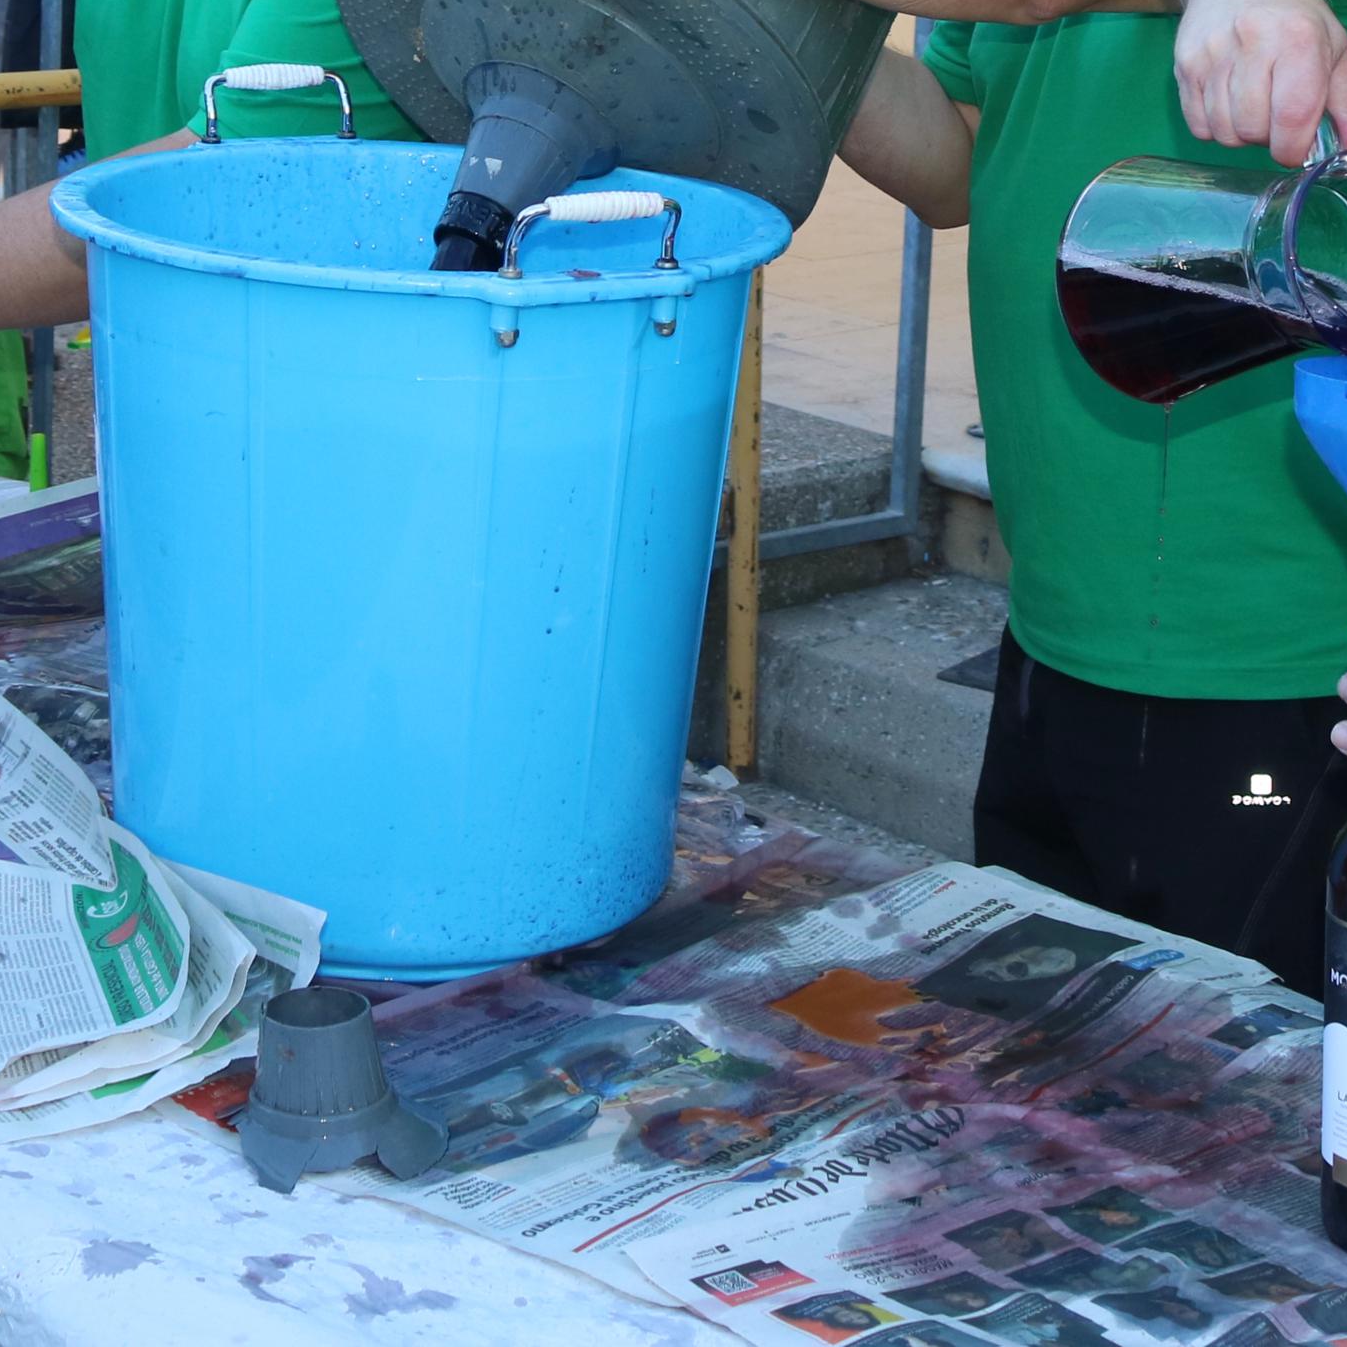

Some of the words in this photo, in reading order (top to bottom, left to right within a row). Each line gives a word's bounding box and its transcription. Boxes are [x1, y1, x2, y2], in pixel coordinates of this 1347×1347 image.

[981, 897, 999, 910] de
[812, 1158, 868, 1184] de
[599, 1180, 670, 1217] palestino
[521, 1201, 600, 1239] Gobierno
[585, 1213, 601, 1223] e
